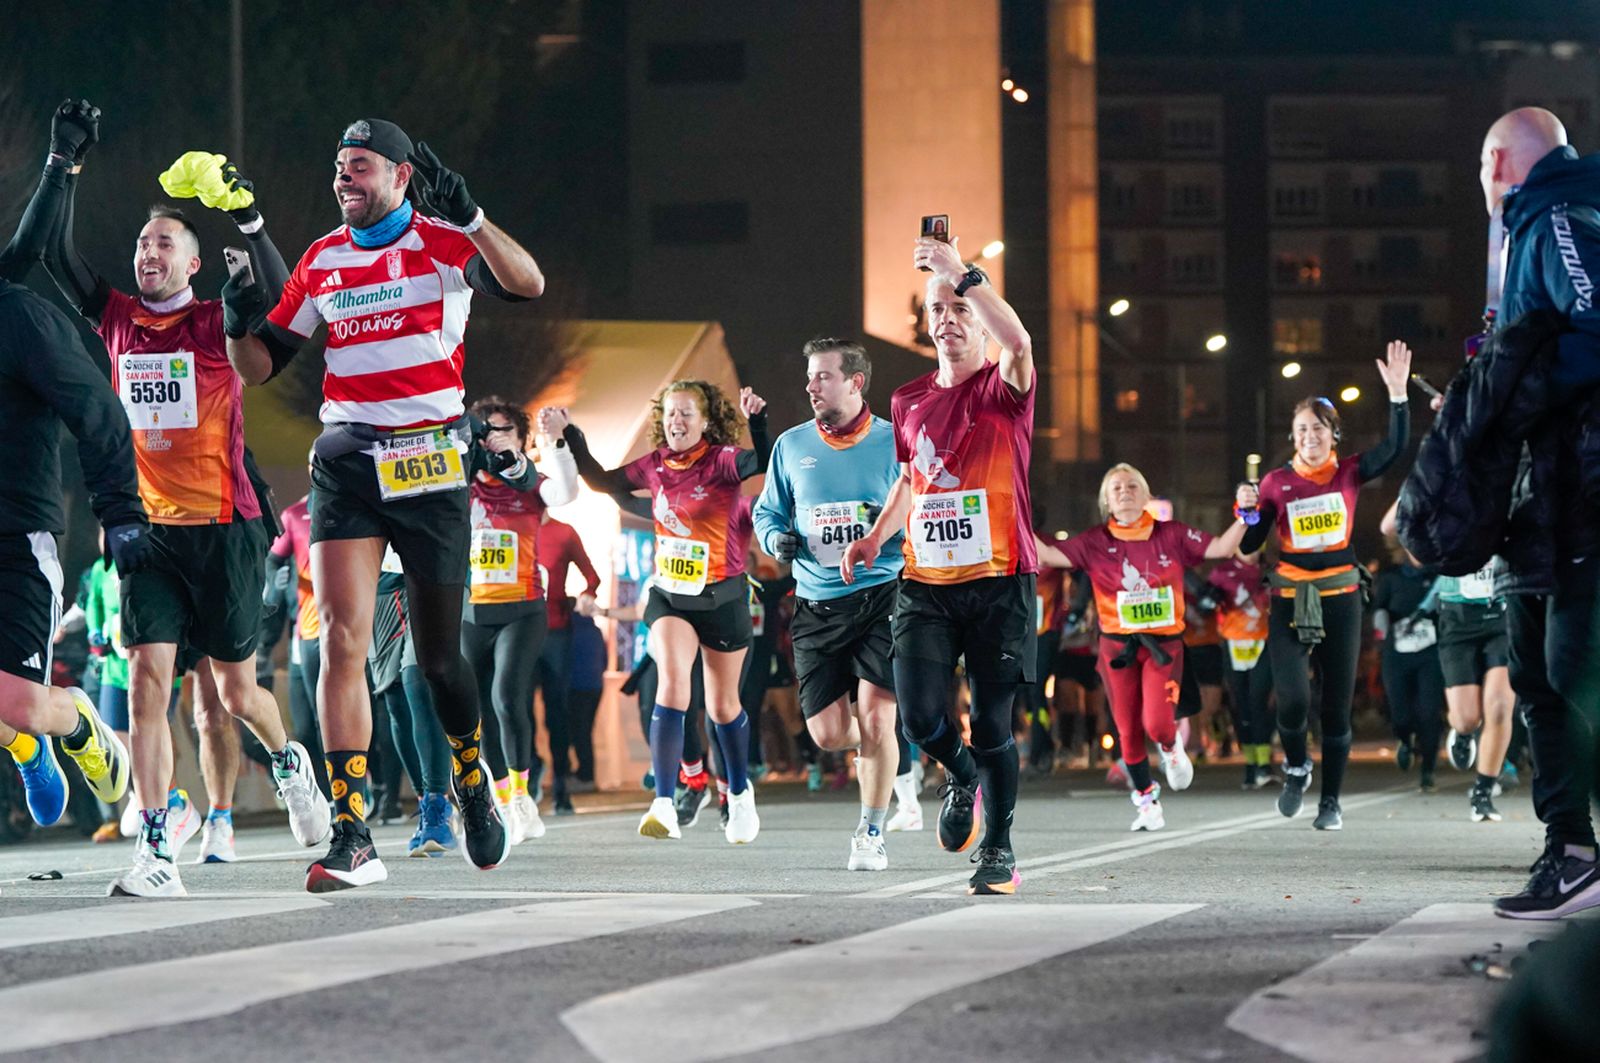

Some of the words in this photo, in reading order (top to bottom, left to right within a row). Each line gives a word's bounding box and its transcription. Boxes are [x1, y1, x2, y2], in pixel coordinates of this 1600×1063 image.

[329, 285, 403, 309] Alhambra
[334, 319, 359, 339] 100
[362, 312, 406, 332] años
[126, 372, 139, 380] SAN
[133, 362, 154, 370] NOCHE
[130, 381, 181, 404] 5530
[416, 436, 426, 444] DE
[394, 452, 447, 482] 4613
[922, 502, 945, 510] NOCHE
[946, 500, 956, 508] DE
[924, 518, 973, 542] 2105
[1298, 512, 1341, 531] 13082
[821, 524, 865, 545] 6418
[1131, 602, 1163, 619] 1146
